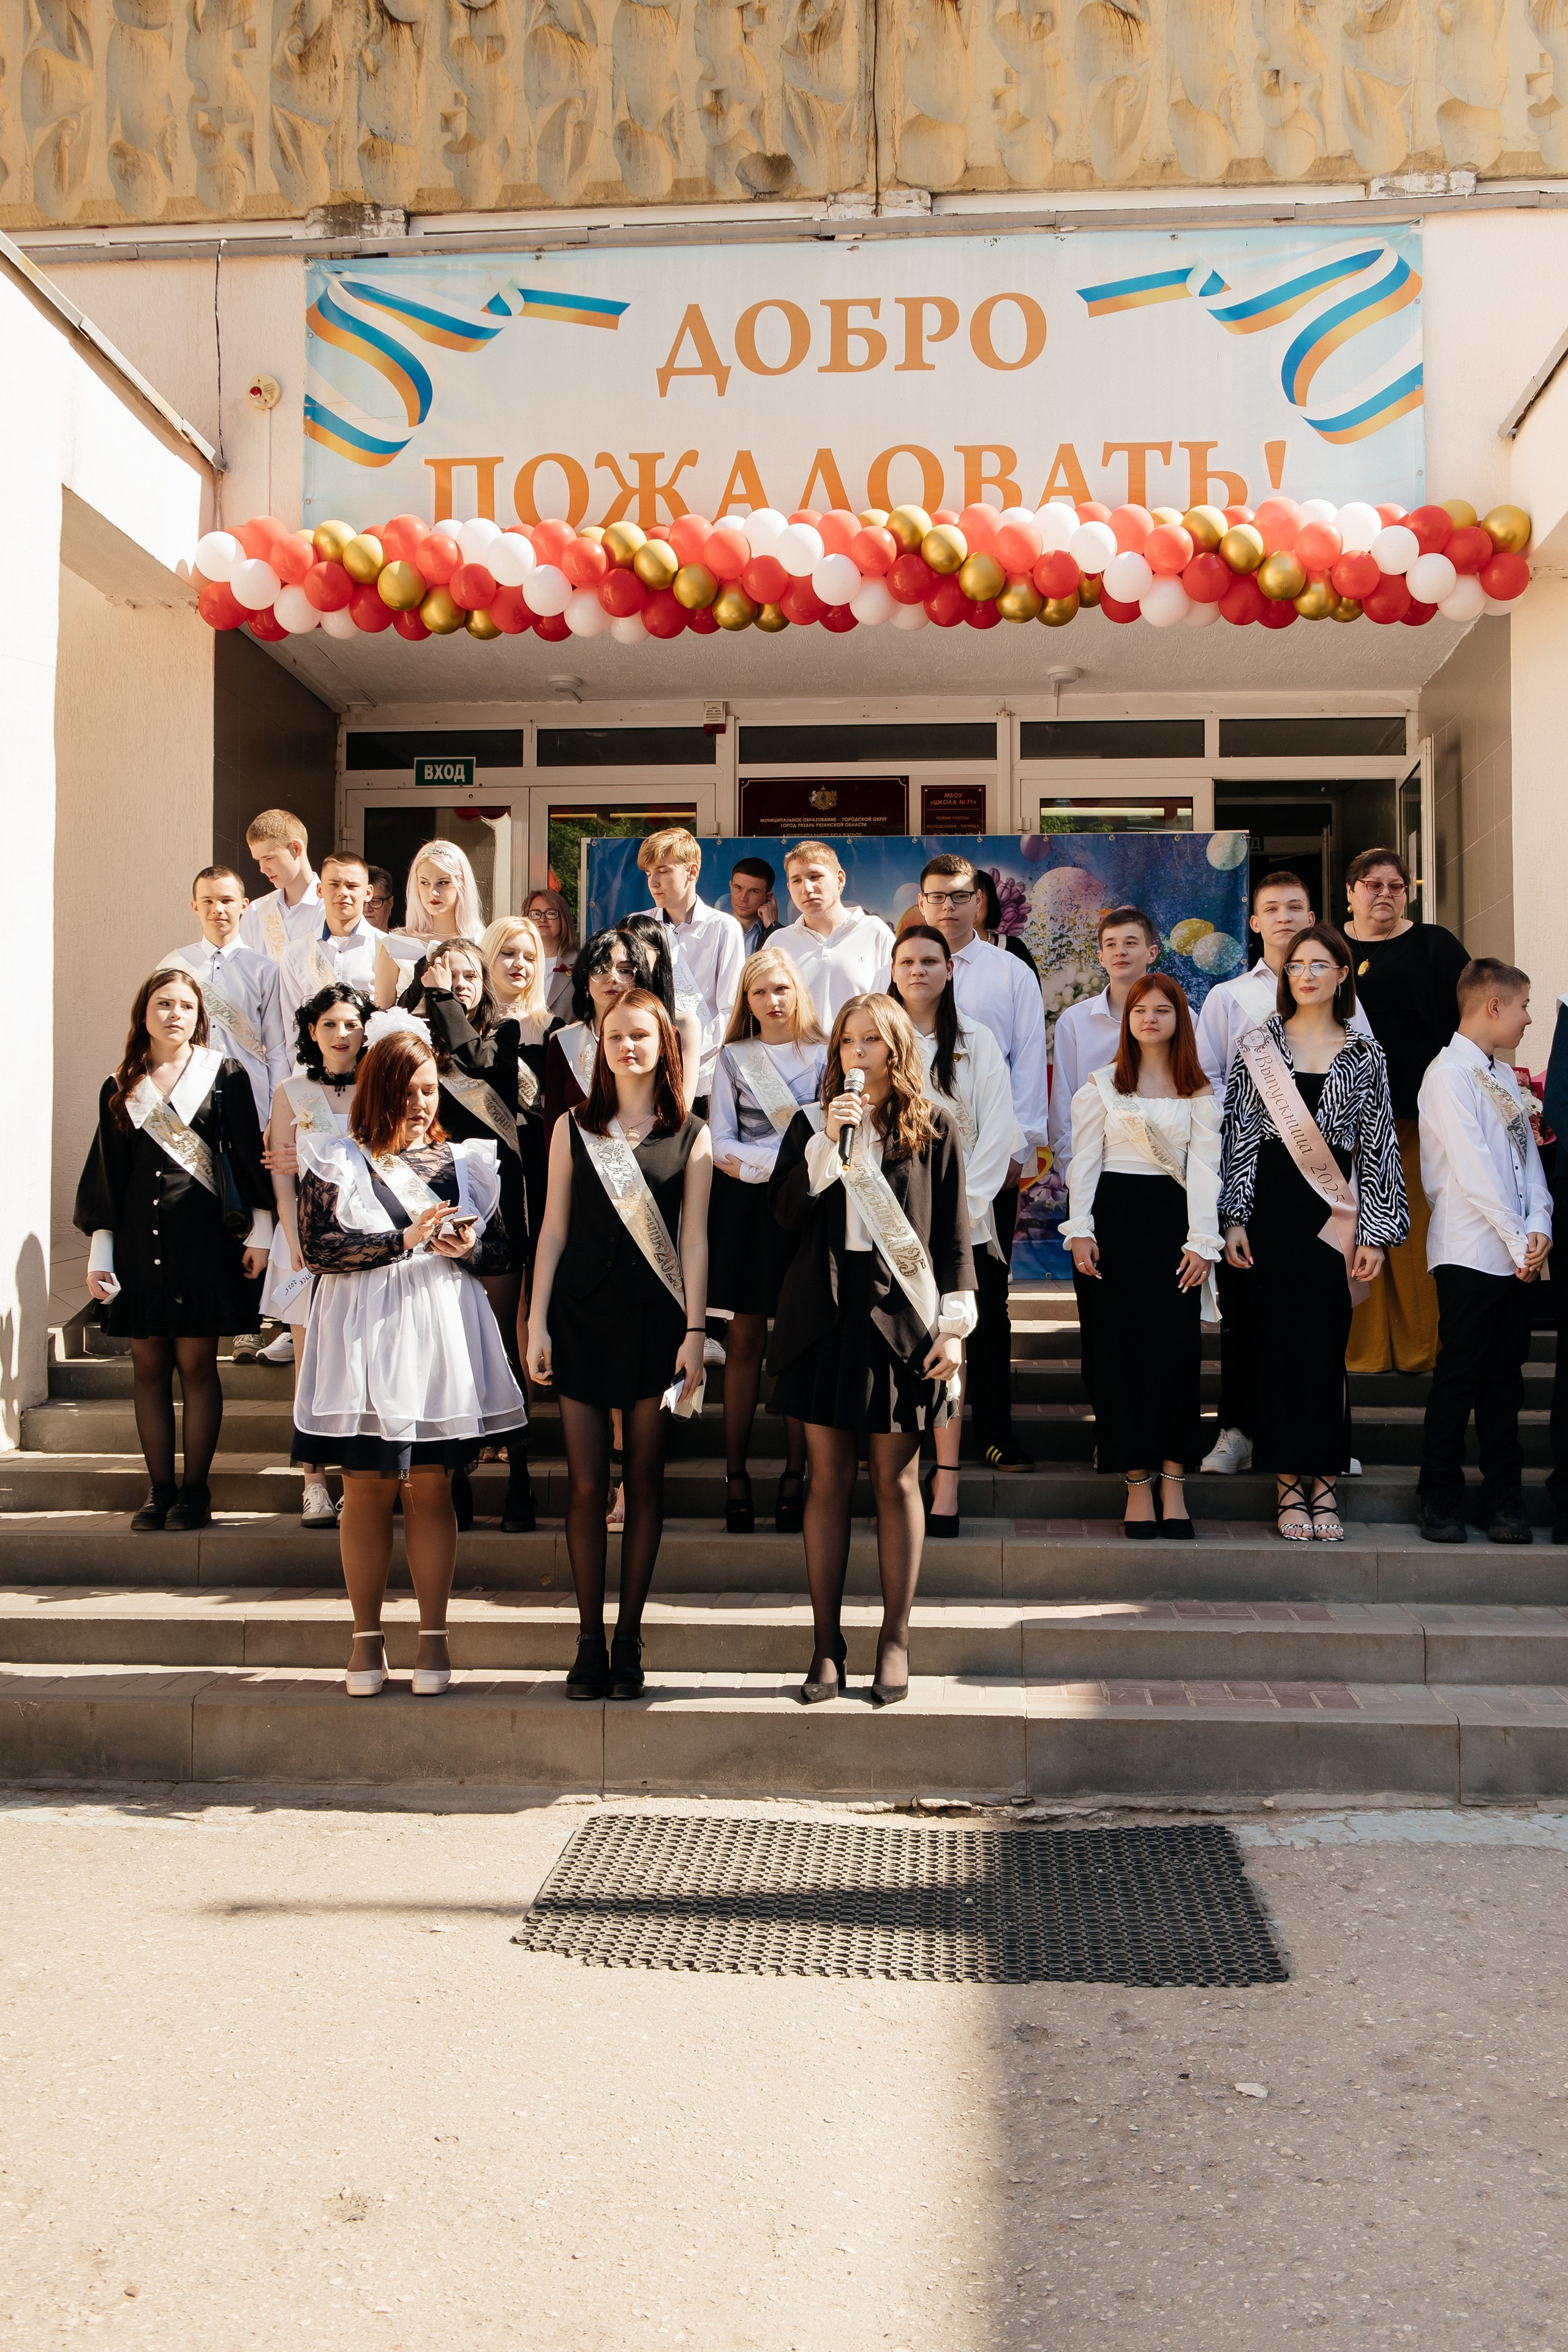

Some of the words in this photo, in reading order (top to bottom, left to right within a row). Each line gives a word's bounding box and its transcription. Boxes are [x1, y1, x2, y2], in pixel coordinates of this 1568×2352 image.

[656, 292, 1047, 398] ДОБРО
[424, 440, 1287, 528] ПОЖАЛОВАТЬ!
[424, 764, 465, 782] ВХОД
[1254, 1051, 1313, 1156] Выпускница
[1310, 1163, 1346, 1203] 2025
[654, 1244, 684, 1293] 2025
[880, 1226, 927, 1277] 2025
